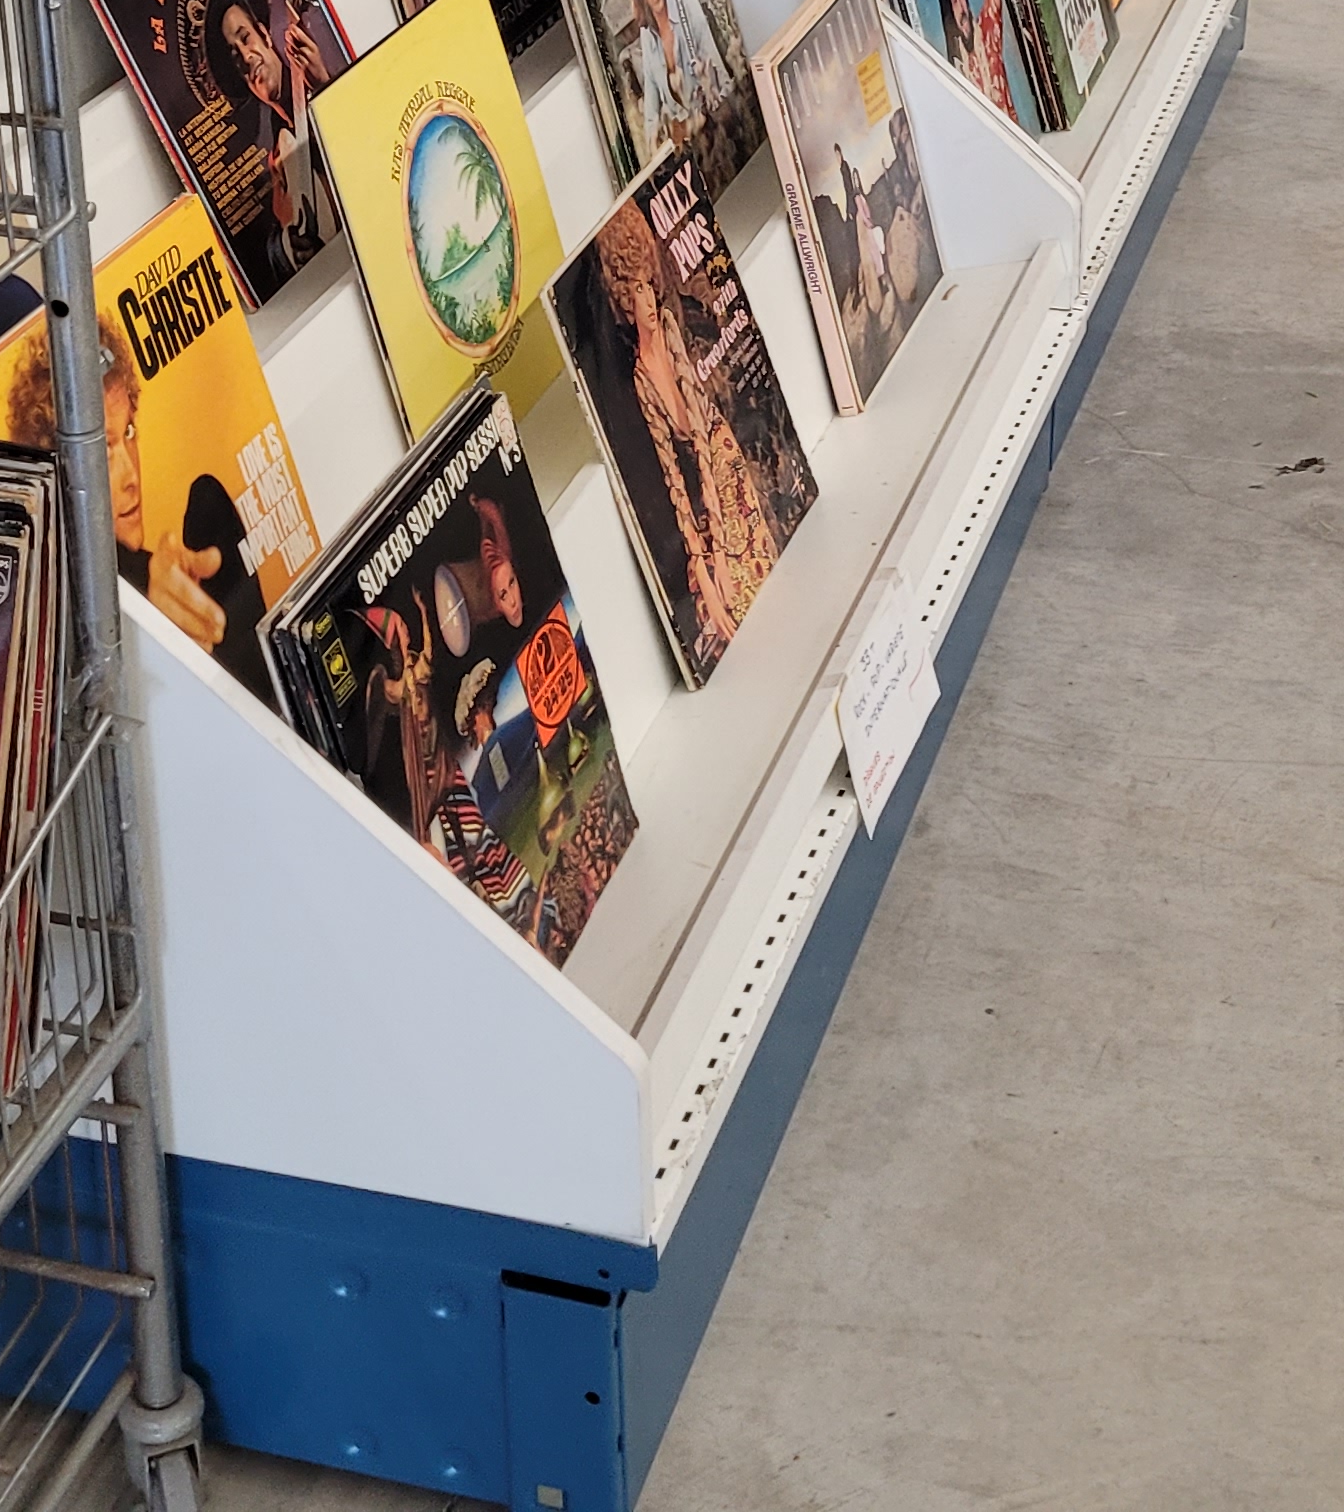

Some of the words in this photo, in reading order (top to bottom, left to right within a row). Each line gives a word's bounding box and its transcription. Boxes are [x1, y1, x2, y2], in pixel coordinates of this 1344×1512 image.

[150, 16, 169, 54] LA
[134, 244, 182, 301] DAVID
[669, 211, 716, 284] POPS
[784, 182, 805, 230] GRAEME
[797, 232, 823, 295] ALLWRIGHT
[117, 247, 232, 382] CHRISTIE
[236, 431, 270, 485] LOVE
[265, 421, 283, 458] IS
[234, 484, 263, 530] THE
[255, 454, 298, 517] MOST
[356, 528, 413, 606] SUPERB
[404, 482, 450, 546] SUPER
[442, 454, 471, 501] POP
[237, 491, 308, 578] IMPORTANT
